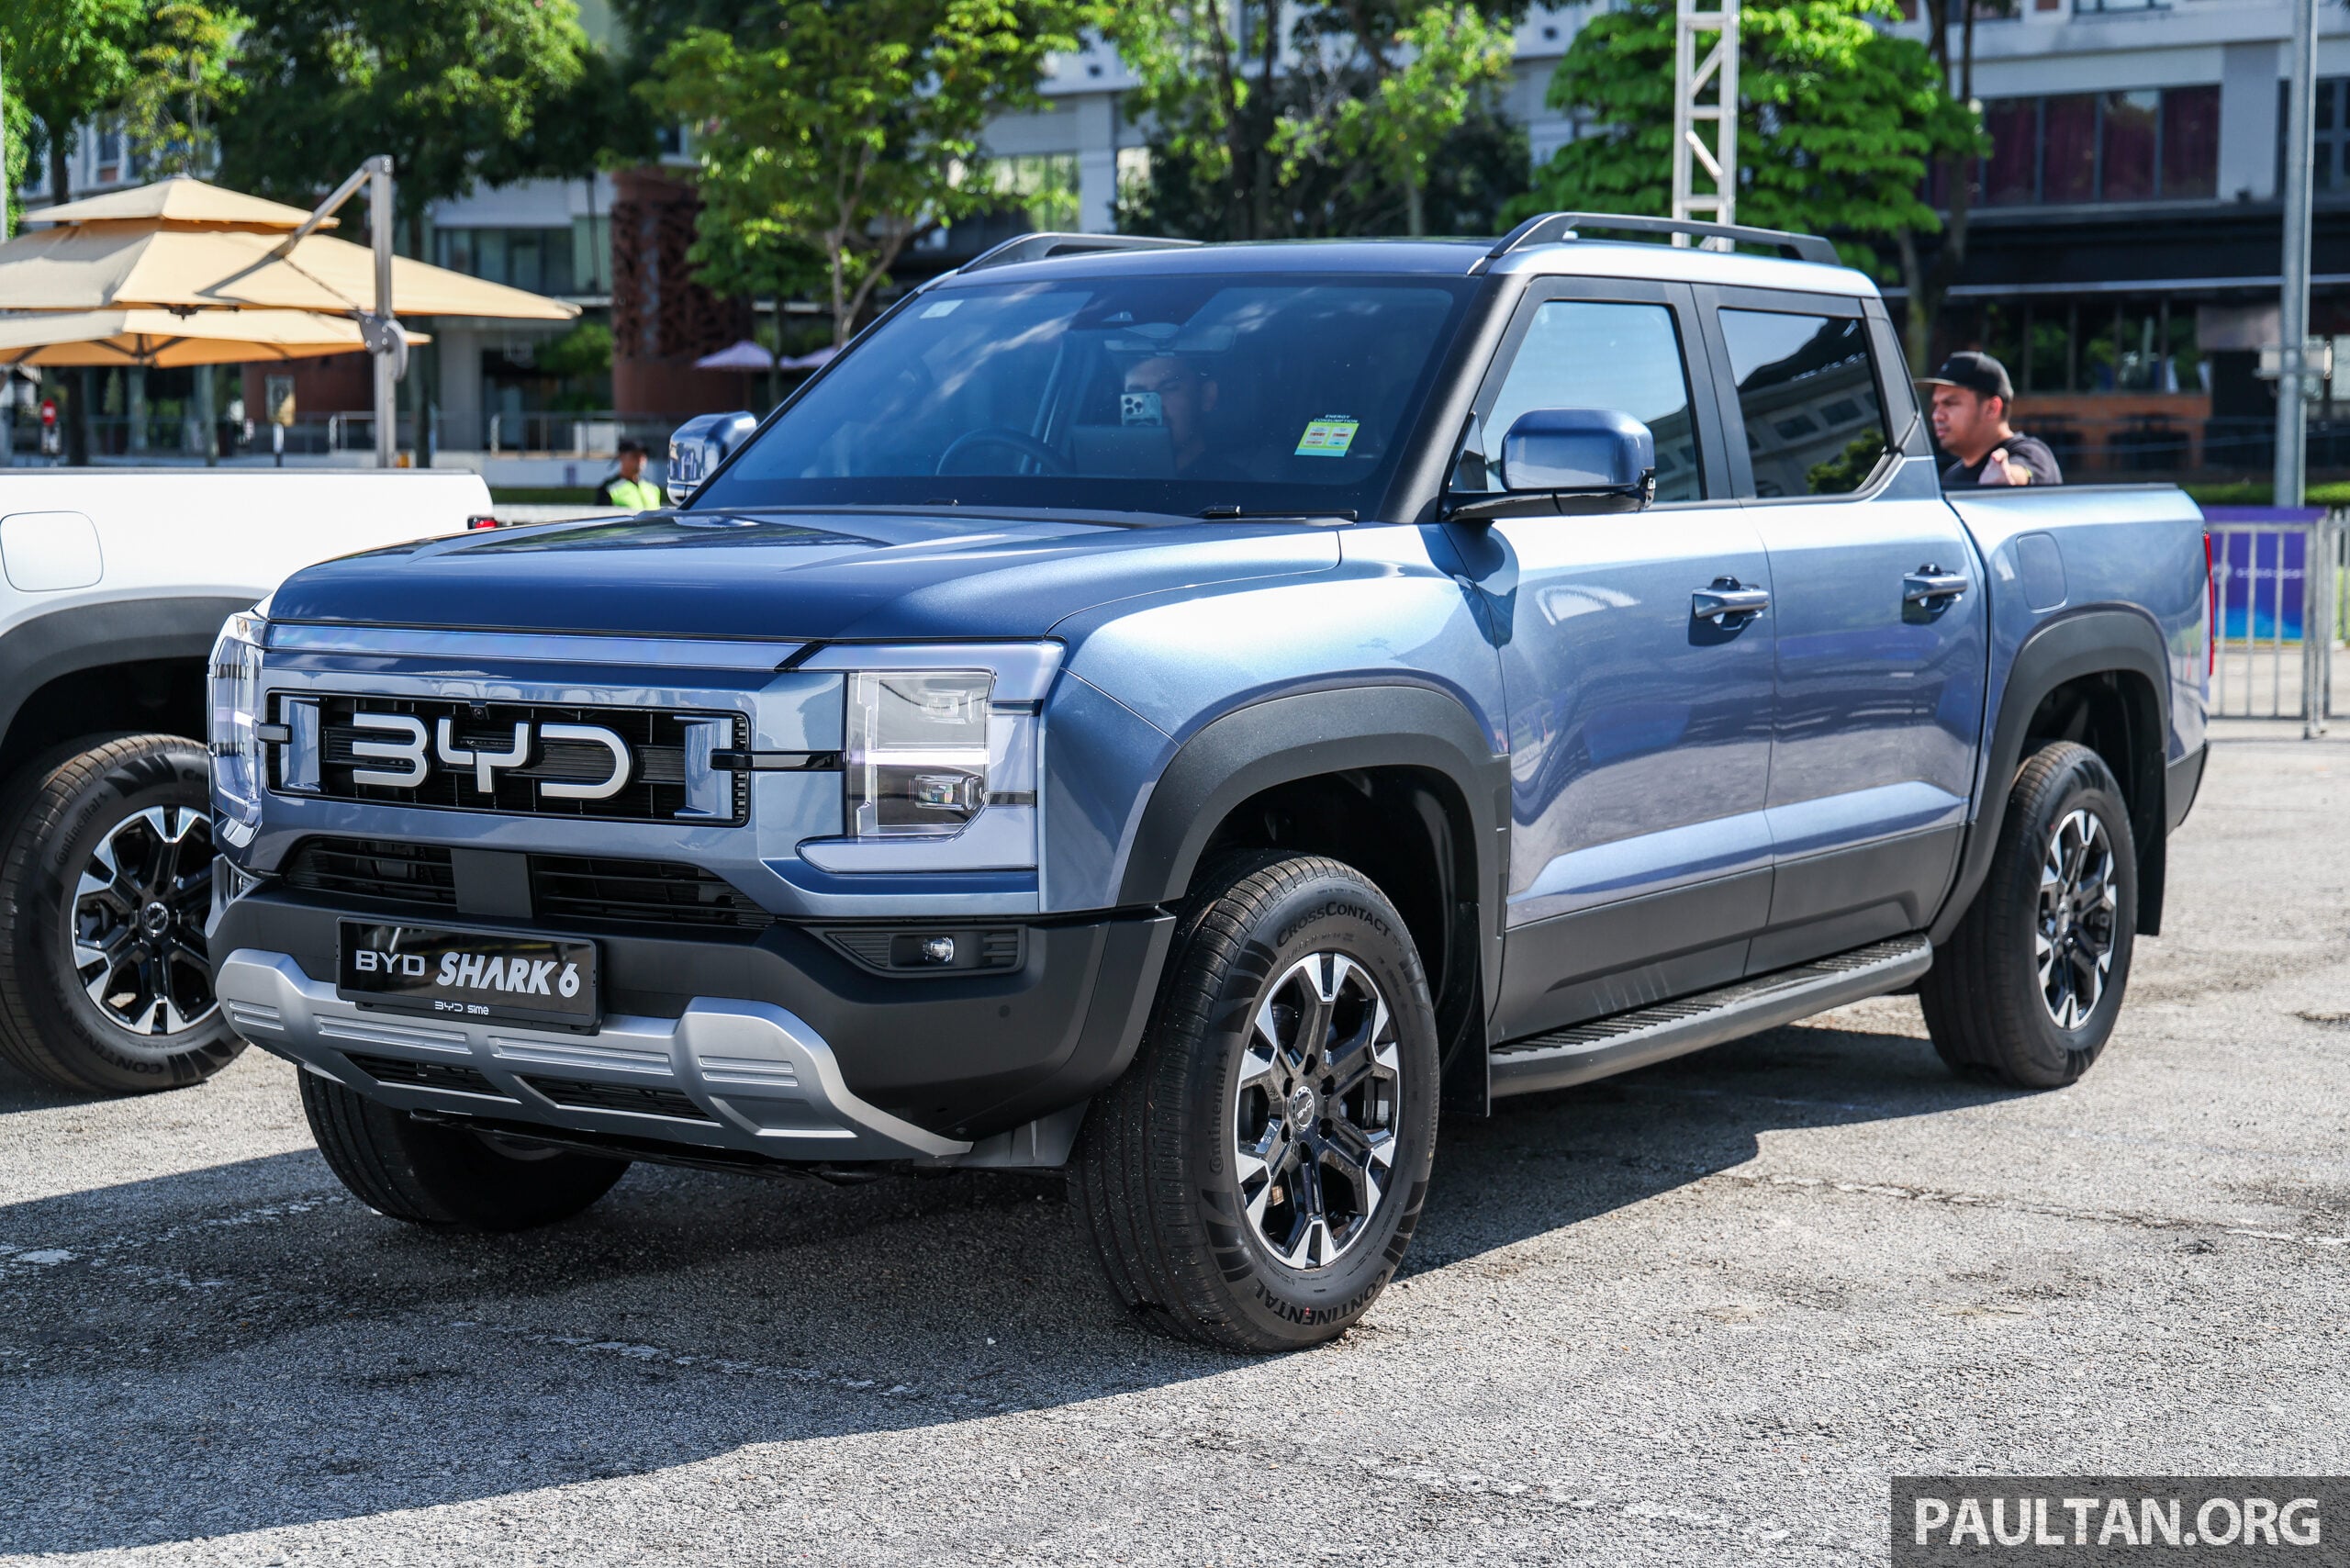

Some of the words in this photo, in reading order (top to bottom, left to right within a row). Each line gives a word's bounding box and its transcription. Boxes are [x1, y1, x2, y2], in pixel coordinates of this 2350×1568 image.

[352, 712, 632, 799] BYD
[355, 949, 425, 977] BYD
[436, 952, 558, 995] SHARK
[558, 963, 580, 998] 6
[434, 1001, 464, 1013] BYD
[467, 1004, 489, 1015] sime
[1255, 1269, 1387, 1326] CONTINENTAL
